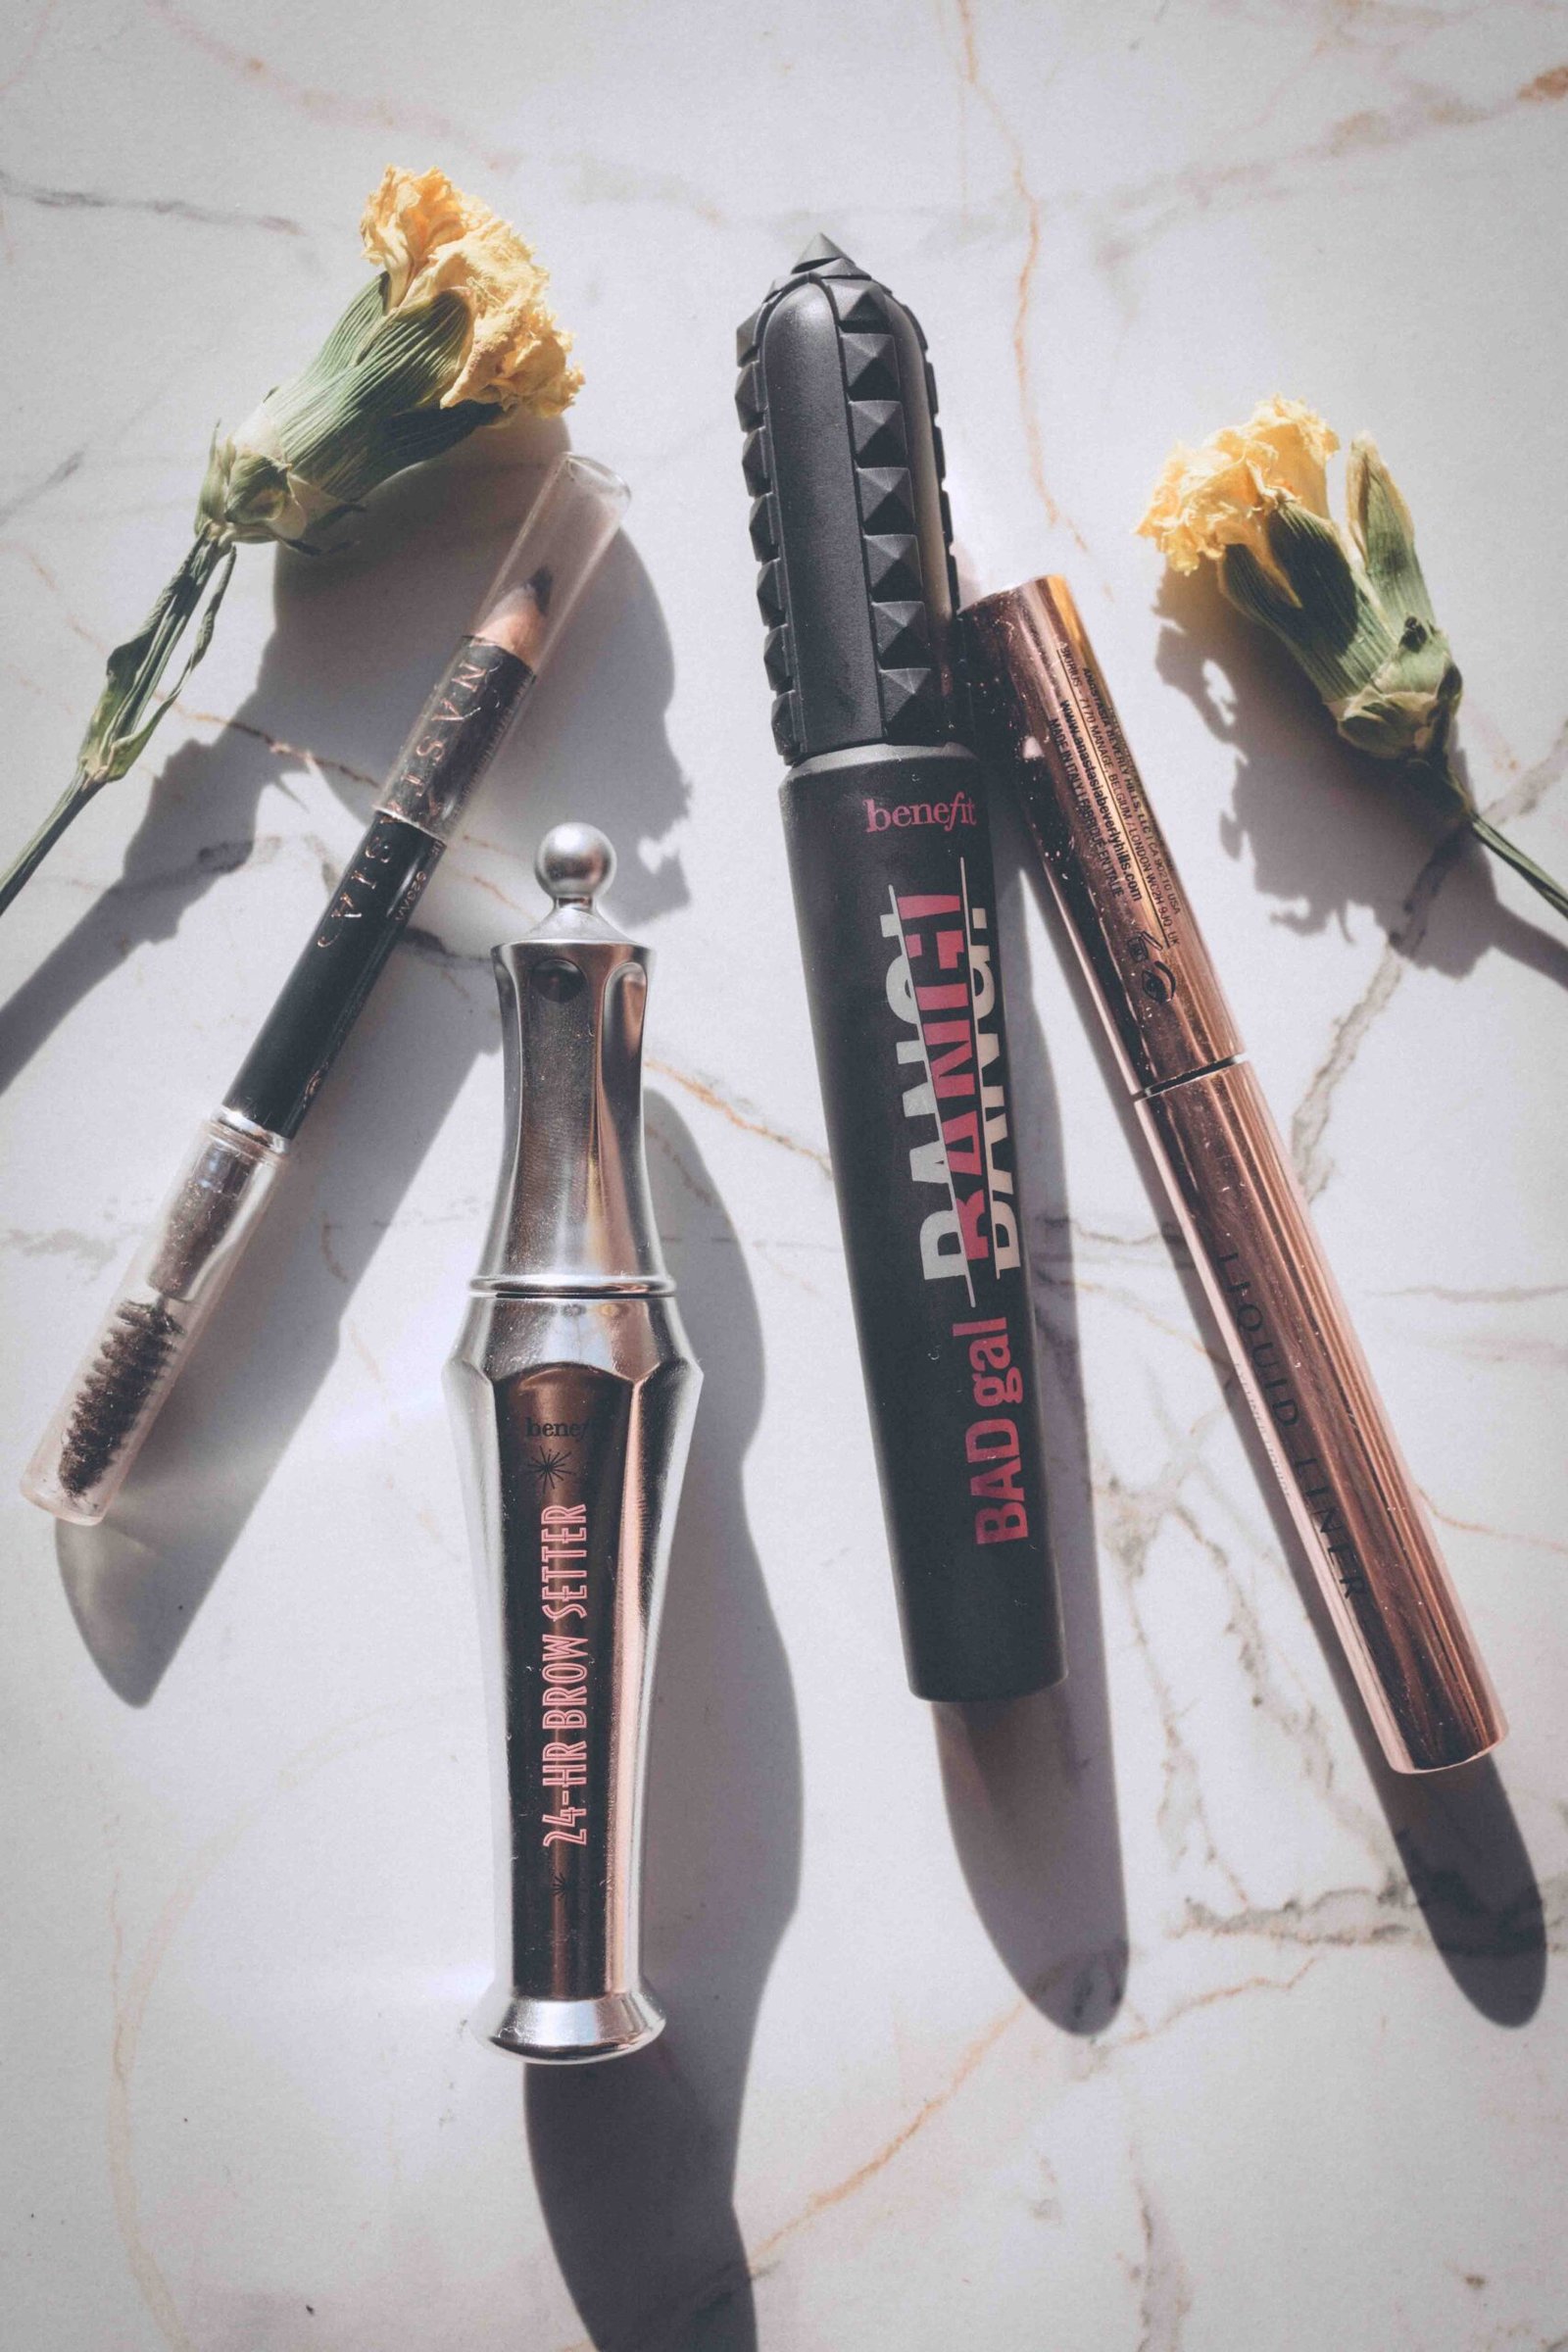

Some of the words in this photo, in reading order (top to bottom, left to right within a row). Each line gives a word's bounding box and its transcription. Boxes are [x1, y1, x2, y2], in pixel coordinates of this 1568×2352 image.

[1079, 696, 1096, 724] 7170
[1082, 665, 1110, 727] ANASTASIA
[1048, 717, 1068, 750] MADE
[1087, 724, 1114, 773] MANAGE,
[1105, 728, 1129, 775] BEVERLY
[1059, 750, 1073, 763] IN
[1064, 762, 1084, 791] ITALY
[1107, 772, 1132, 819] BELGIUM
[1122, 777, 1142, 811] HILLS,
[863, 791, 977, 833] benefit
[1057, 698, 1145, 902] www.anastasiabeverlyhills.com
[1137, 812, 1151, 834] LLC
[1097, 850, 1111, 865] EN
[1128, 827, 1152, 872] LONDON
[1148, 842, 1159, 857] CA
[1102, 865, 1124, 898] ITALIE
[1145, 872, 1163, 905] WC2H
[1153, 858, 1172, 891] 90210
[1166, 893, 1181, 914] USA
[1166, 931, 1180, 947] UK
[952, 1317, 1024, 1407] gal
[1218, 1251, 1298, 1427] LIQUID
[1296, 1457, 1365, 1599] LINER
[964, 1418, 1029, 1545] BAD
[541, 1503, 587, 1621] SETTER
[542, 1634, 589, 1729] BROW
[542, 1740, 588, 1847] 24-HR
